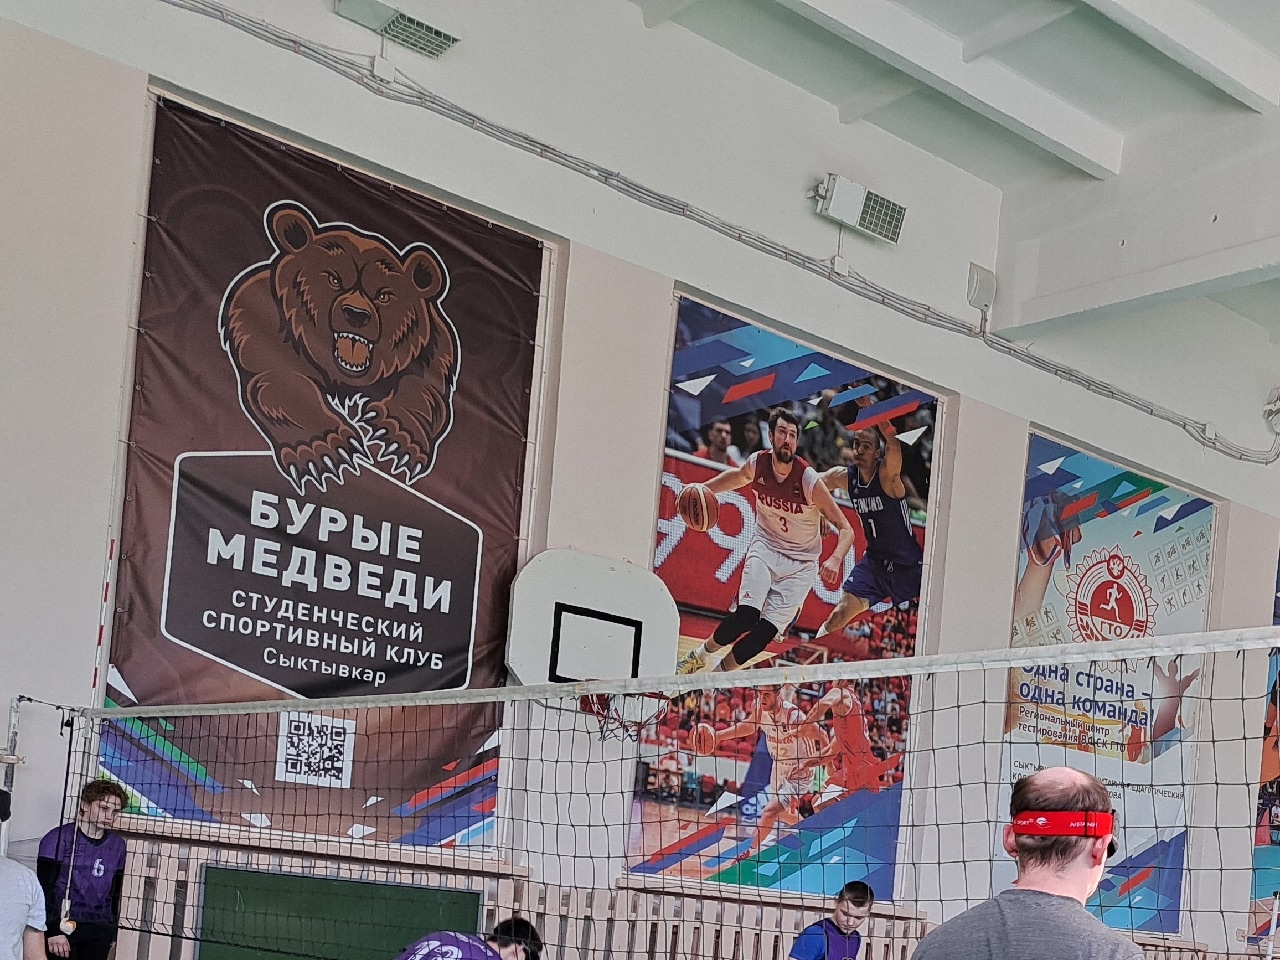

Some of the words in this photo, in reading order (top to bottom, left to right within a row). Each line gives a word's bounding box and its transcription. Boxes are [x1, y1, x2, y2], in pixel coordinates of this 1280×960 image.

[759, 494, 804, 515] RUSSIA
[250, 489, 423, 563] БУРЫЕ
[779, 516, 789, 533] 3
[867, 518, 877, 539] 1
[206, 527, 452, 614] МЕДВЕДИ
[231, 589, 424, 643] СТУДЕНЧЕСКИЙ
[1101, 621, 1122, 638] ГТО
[202, 609, 376, 659] СПОРТИВНЫЙ
[385, 643, 443, 670] КЛУБ
[262, 646, 387, 688] Сыктывкар
[1075, 671, 1135, 700] страна
[1019, 682, 1065, 707] одна
[1071, 694, 1155, 728] команда!
[1017, 722, 1079, 743] тестирования
[1081, 734, 1108, 751] ВФСК
[1019, 705, 1083, 730] Региональный
[1084, 721, 1110, 738] центр
[91, 858, 105, 878] 6
